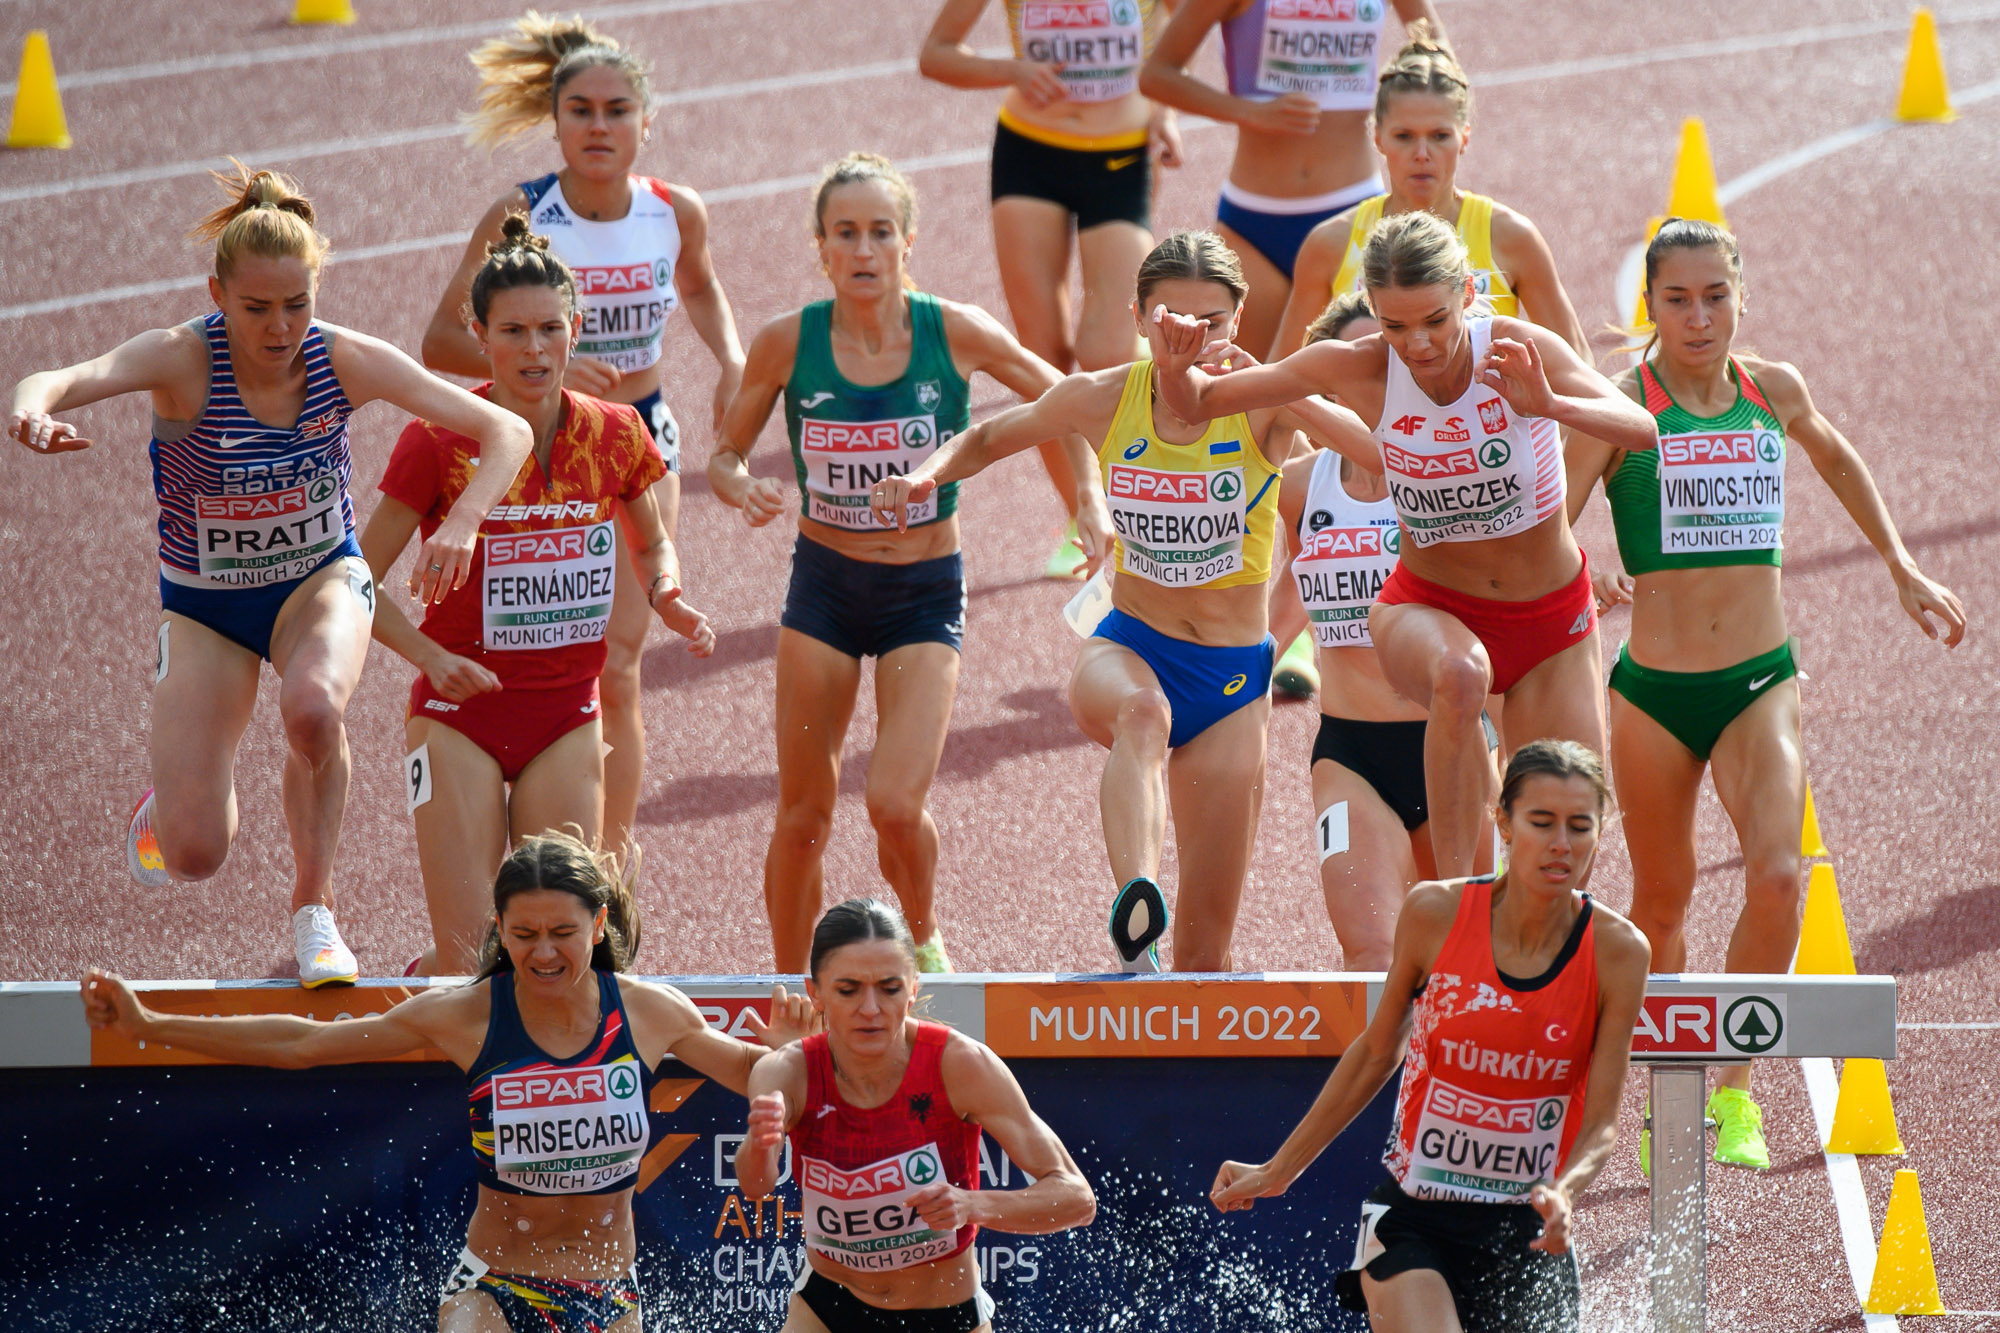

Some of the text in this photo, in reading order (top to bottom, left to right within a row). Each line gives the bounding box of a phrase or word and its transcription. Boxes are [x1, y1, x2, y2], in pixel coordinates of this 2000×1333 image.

[1028, 33, 1138, 63] GÜRTH
[1269, 30, 1377, 57] THORNER
[1266, 73, 1366, 92] MUNICH 2022
[582, 298, 674, 335] EMITRE
[807, 426, 896, 449] SPAR
[1392, 415, 1427, 435] 4F
[1436, 429, 1469, 442] ORLEN
[1386, 446, 1475, 476] SPAR
[1665, 437, 1754, 463] SPAR
[223, 450, 334, 482] GREAT
[1111, 471, 1204, 499] SPAR
[1390, 474, 1523, 513] KONIECZEK
[1665, 469, 1781, 508] VINDICS-TÓTH
[201, 492, 303, 516] SPAR
[486, 500, 598, 521] ESPAÑA
[840, 496, 864, 506] RUN
[208, 507, 334, 553] PRATT
[1112, 509, 1240, 544] STREBKOVA
[1427, 516, 1454, 527] RUN
[1481, 505, 1524, 535] 2022
[1701, 515, 1726, 525] RUN
[491, 532, 582, 562] SPAR
[1671, 528, 1777, 547] MUNICH 202
[242, 556, 269, 568] RUN
[1129, 552, 1234, 582] MUNICH 2022
[488, 566, 612, 606] FERNÁNDEZ
[524, 613, 549, 624] RUN
[1328, 609, 1353, 620] RUN
[493, 619, 607, 645] MUNICH 2022
[1316, 623, 1370, 641] UNICH
[425, 699, 459, 713] ESP
[411, 758, 421, 801] 9
[1320, 816, 1330, 852] 1
[1030, 1006, 1321, 1041] MUNICH 2022
[1441, 1039, 1572, 1081] TÜRKİYE
[499, 1075, 603, 1106] SPAR
[1432, 1089, 1532, 1128] SPAR
[499, 1112, 643, 1156] PRISECARU
[539, 1160, 567, 1171] RUN
[1420, 1127, 1555, 1180] GÜVENÇ
[808, 1167, 902, 1196] SPAR
[1453, 1173, 1480, 1188] RUN
[901, 1241, 948, 1264] 2022
[713, 1288, 794, 1312] MUNI
